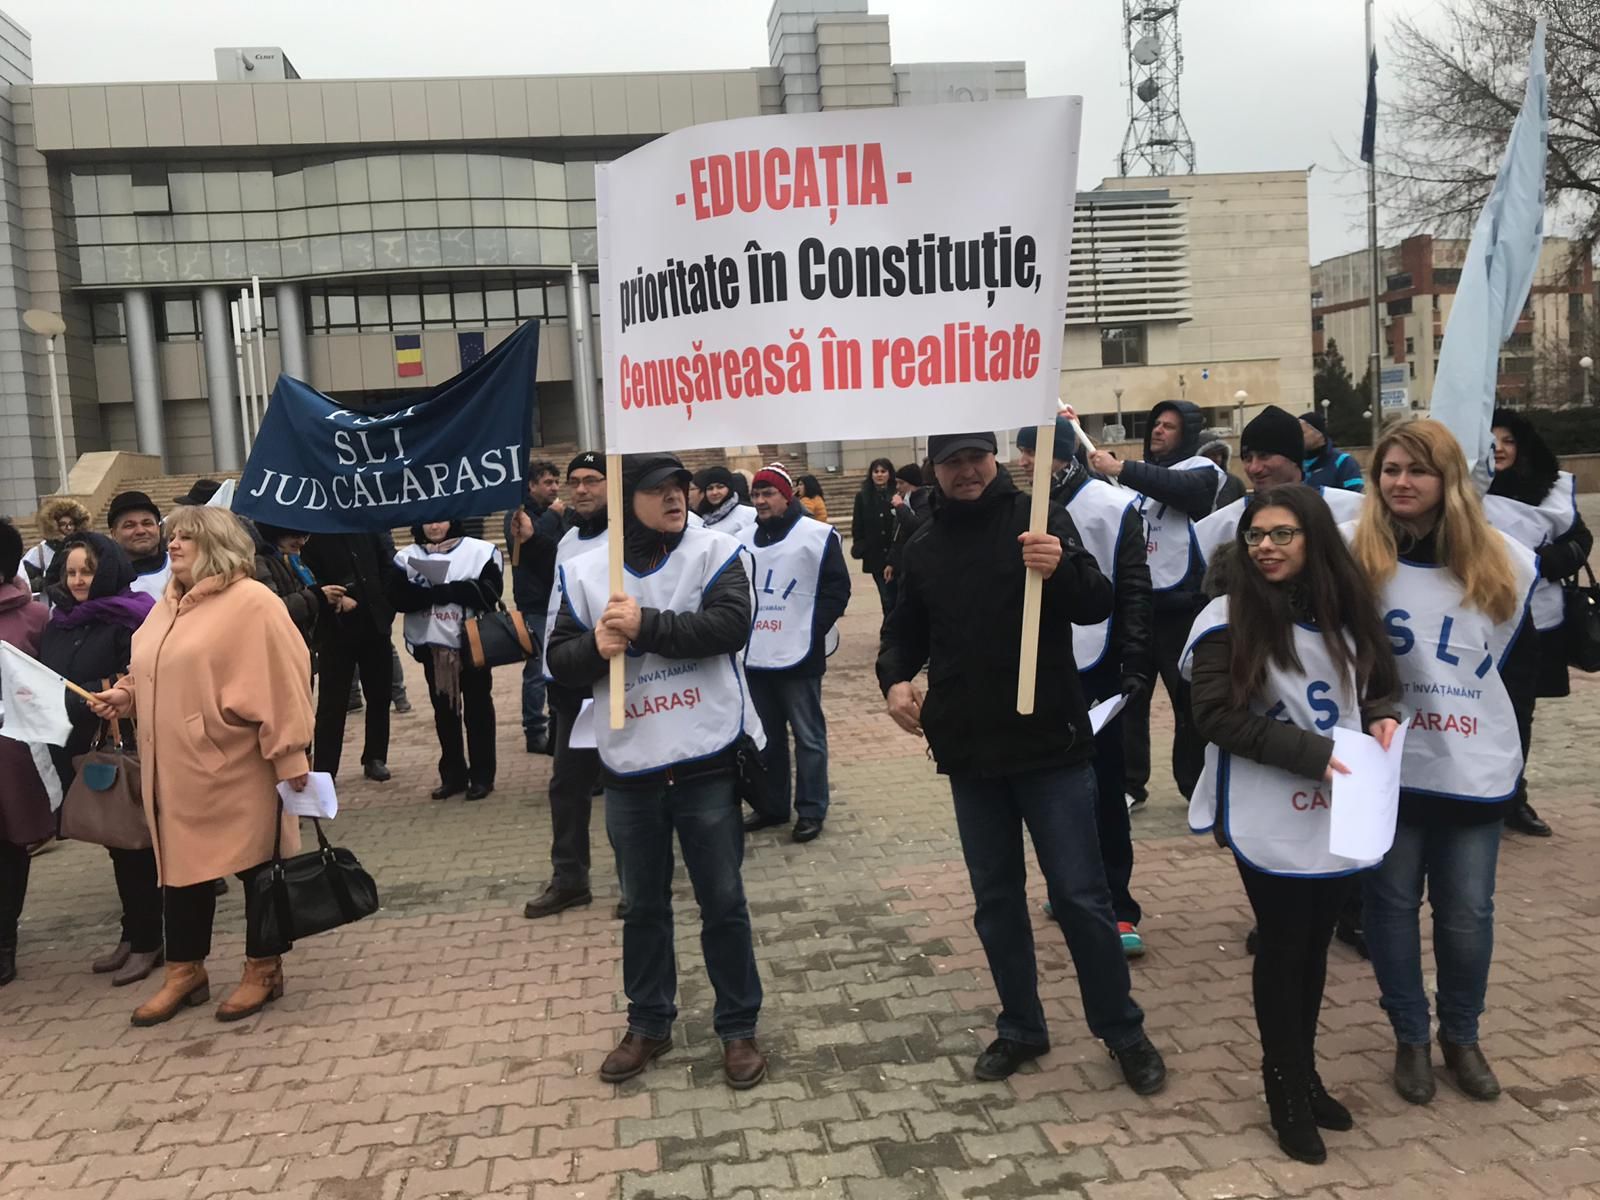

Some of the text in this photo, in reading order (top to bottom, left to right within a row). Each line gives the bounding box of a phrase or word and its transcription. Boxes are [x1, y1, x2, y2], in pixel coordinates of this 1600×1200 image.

[690, 142, 889, 226] EDUCAȚIA
[619, 225, 1042, 333] prioritate în Constituție,
[620, 321, 1041, 421] Cenușăreasă în realitate
[334, 426, 405, 465] SLI
